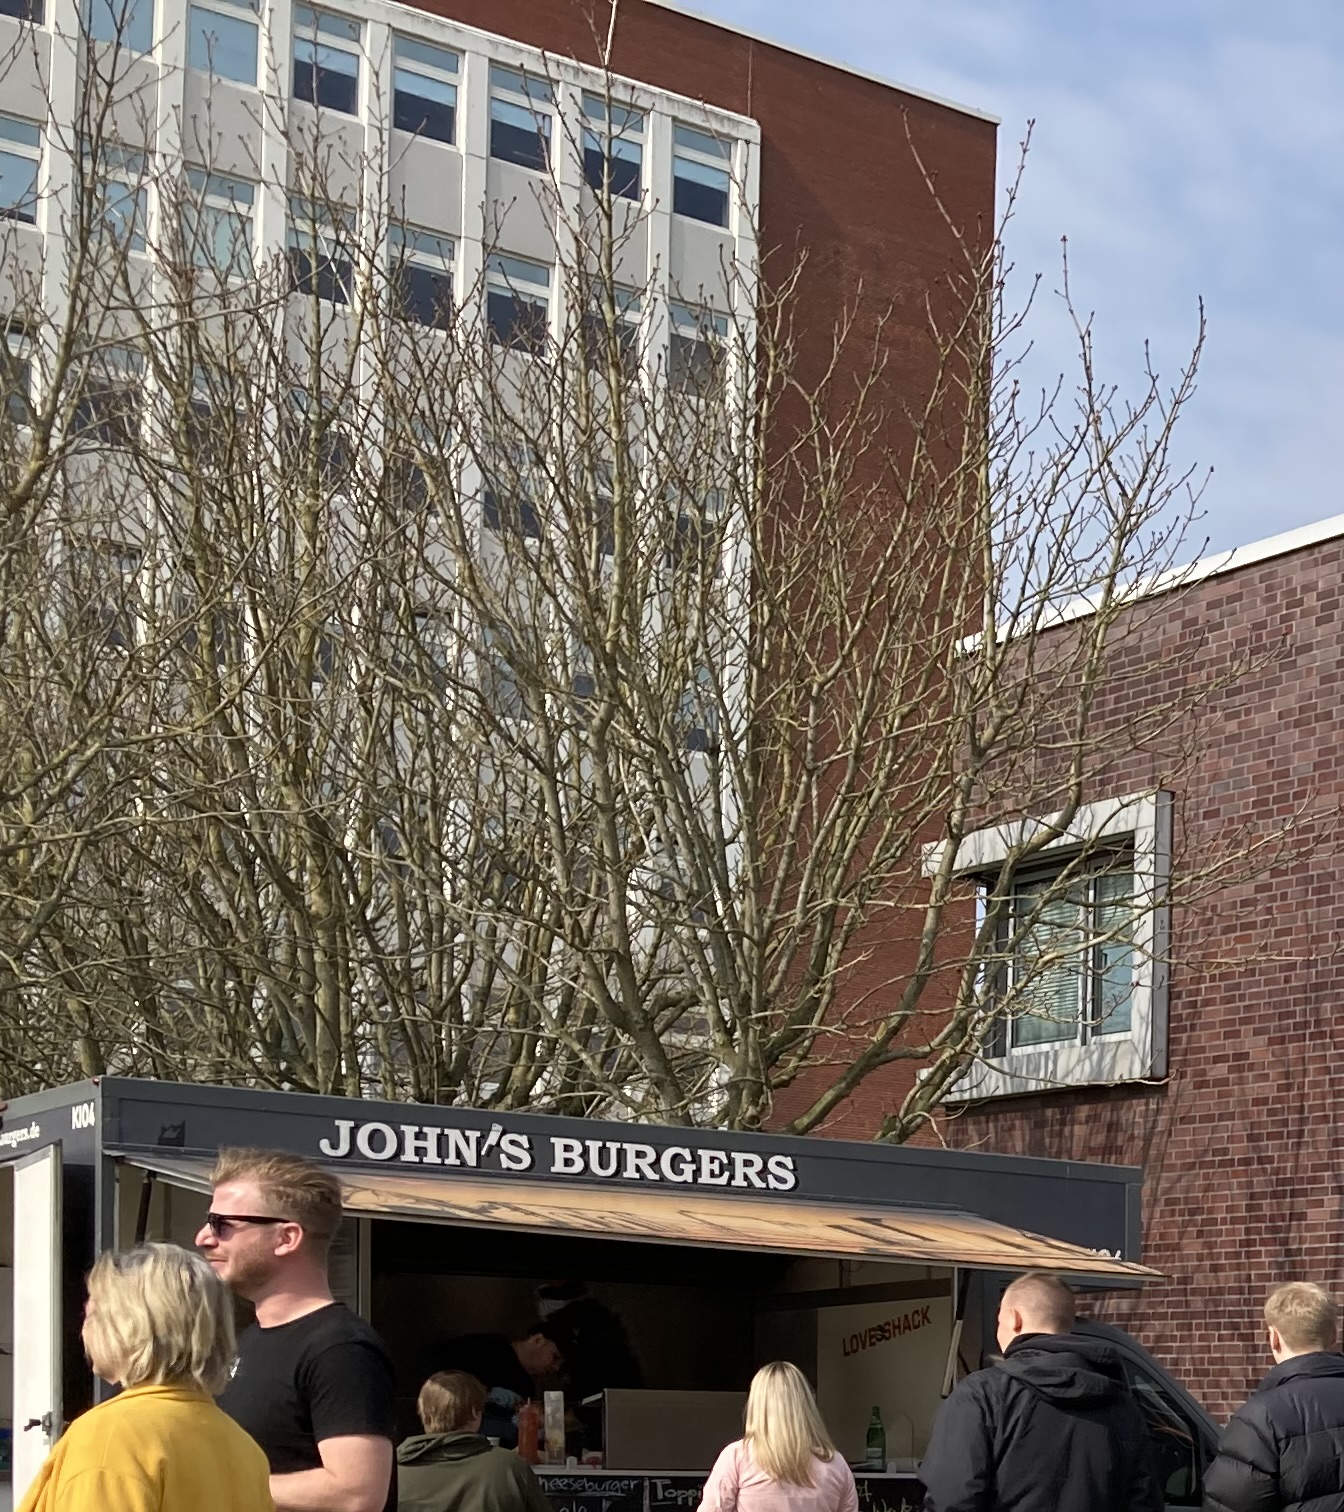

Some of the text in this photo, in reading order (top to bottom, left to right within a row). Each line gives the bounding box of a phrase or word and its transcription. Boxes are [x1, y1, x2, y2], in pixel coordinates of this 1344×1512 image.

[319, 1119, 797, 1191] JOHN'S BURGERS
[538, 1477, 636, 1493] heeseburger
